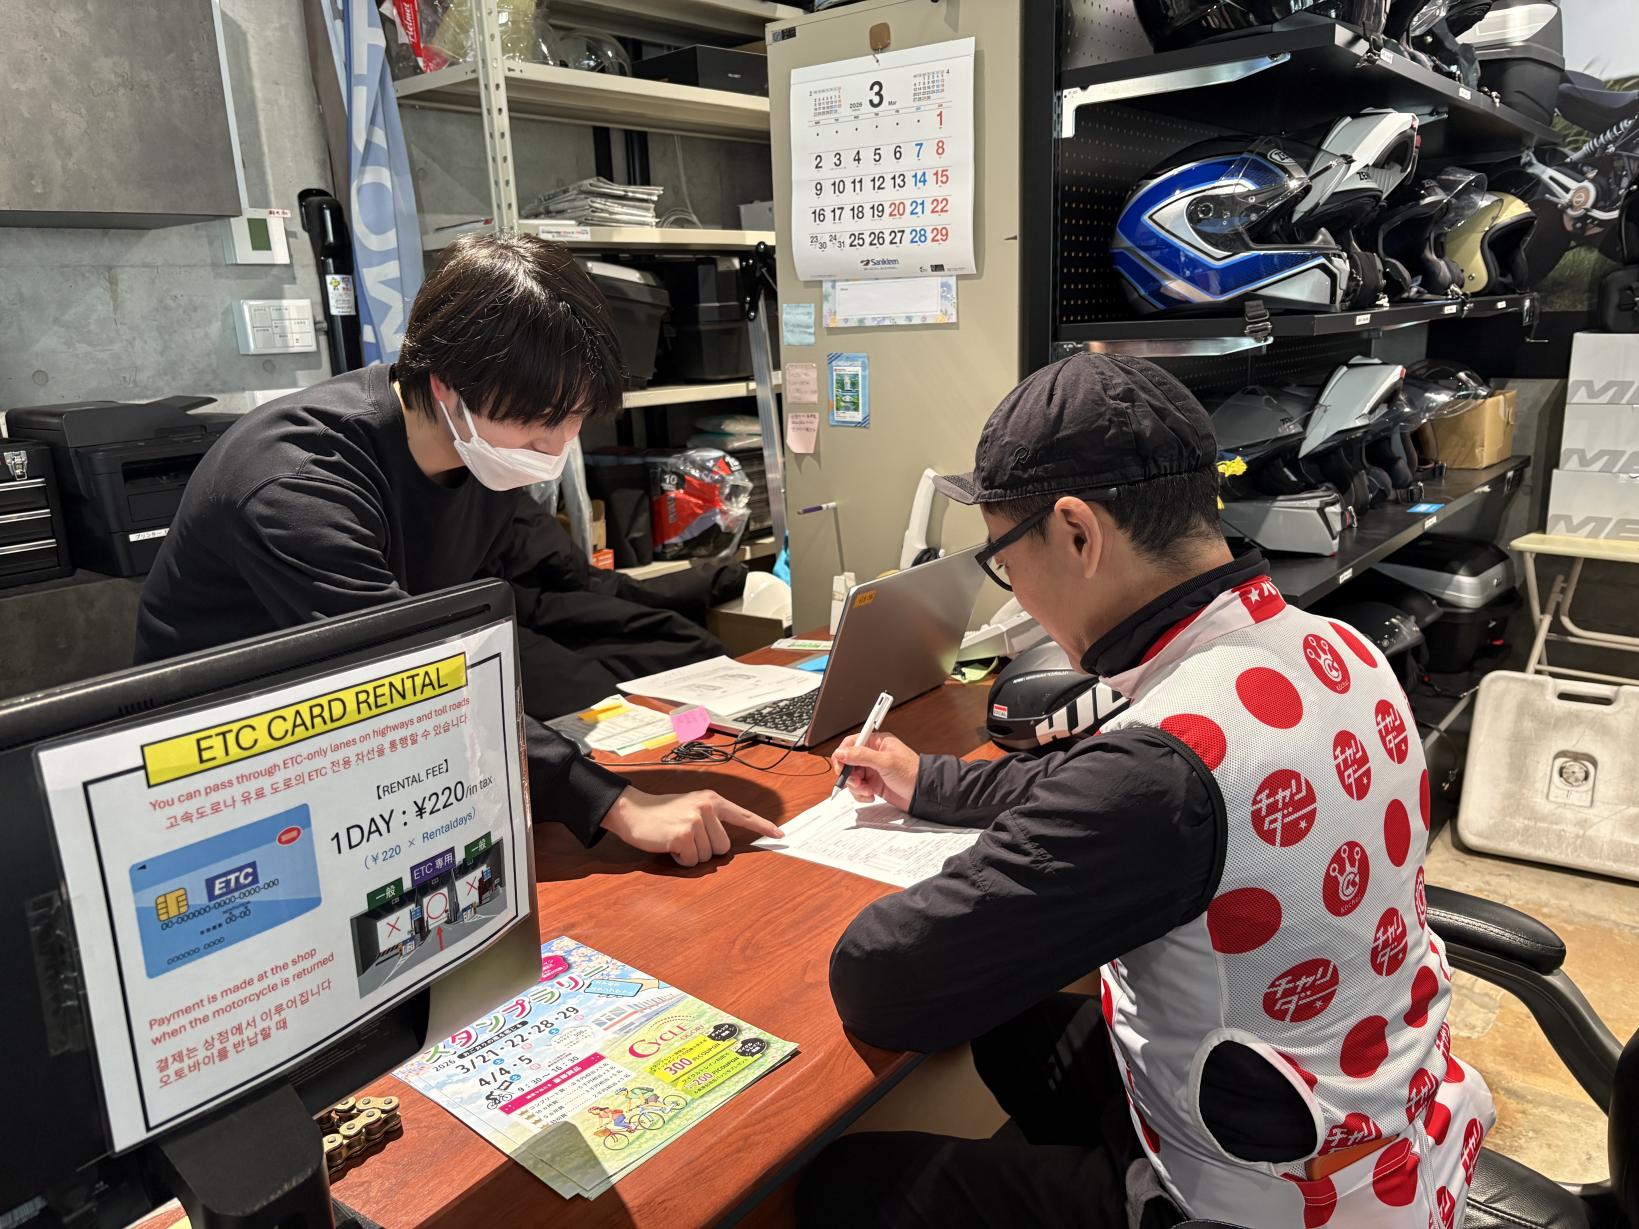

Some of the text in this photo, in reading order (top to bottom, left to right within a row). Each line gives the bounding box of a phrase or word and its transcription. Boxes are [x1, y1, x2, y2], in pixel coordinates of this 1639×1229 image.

[869, 80, 884, 109] 3
[936, 111, 943, 126] 1
[814, 140, 945, 169] 2 3 4 5 6 7 8
[814, 169, 949, 196] 9 10 11 12 13 14 15
[812, 198, 949, 223] 16 17 18 19 20 21 22
[818, 241, 827, 250] 30
[849, 233, 865, 247] 25
[869, 231, 885, 246] 26
[889, 230, 905, 245] 27
[910, 228, 927, 243] 28
[931, 227, 948, 242] 29
[664, 474, 677, 484] 10
[196, 668, 448, 764] ETC CARD RENTAL
[150, 697, 470, 812] You can pass through ETC-only lanes on highways and toll roads
[1334, 738, 1362, 770] チャリ
[165, 796, 236, 830] 고속도로나
[241, 787, 266, 805] 유료
[270, 772, 305, 794] 도로의
[308, 767, 327, 781] ETC
[330, 757, 352, 773] 전용
[355, 744, 386, 766] 차선을
[389, 732, 418, 752] 통행할
[422, 729, 431, 740] 수
[1251, 773, 1307, 816] チャリ
[330, 809, 394, 854] 1DAY
[479, 775, 493, 789] tax
[422, 807, 476, 843] Rentaldays)
[1264, 802, 1317, 847] ダー
[471, 838, 487, 852] 一般
[214, 867, 253, 896] ETC
[414, 866, 433, 879] ETC
[376, 884, 395, 899] 一般
[1373, 913, 1403, 951] チャリ
[149, 948, 317, 1030] Payment is made at the shop
[1267, 961, 1335, 998] チャリ
[150, 952, 335, 1046] when the motorcycle is returned
[1274, 985, 1339, 1022] ダー
[156, 978, 332, 1072] 결제는 상점에서 이루어집니다
[159, 1018, 288, 1088] 오토바이를 반납할 때
[433, 1058, 455, 1072] 2026
